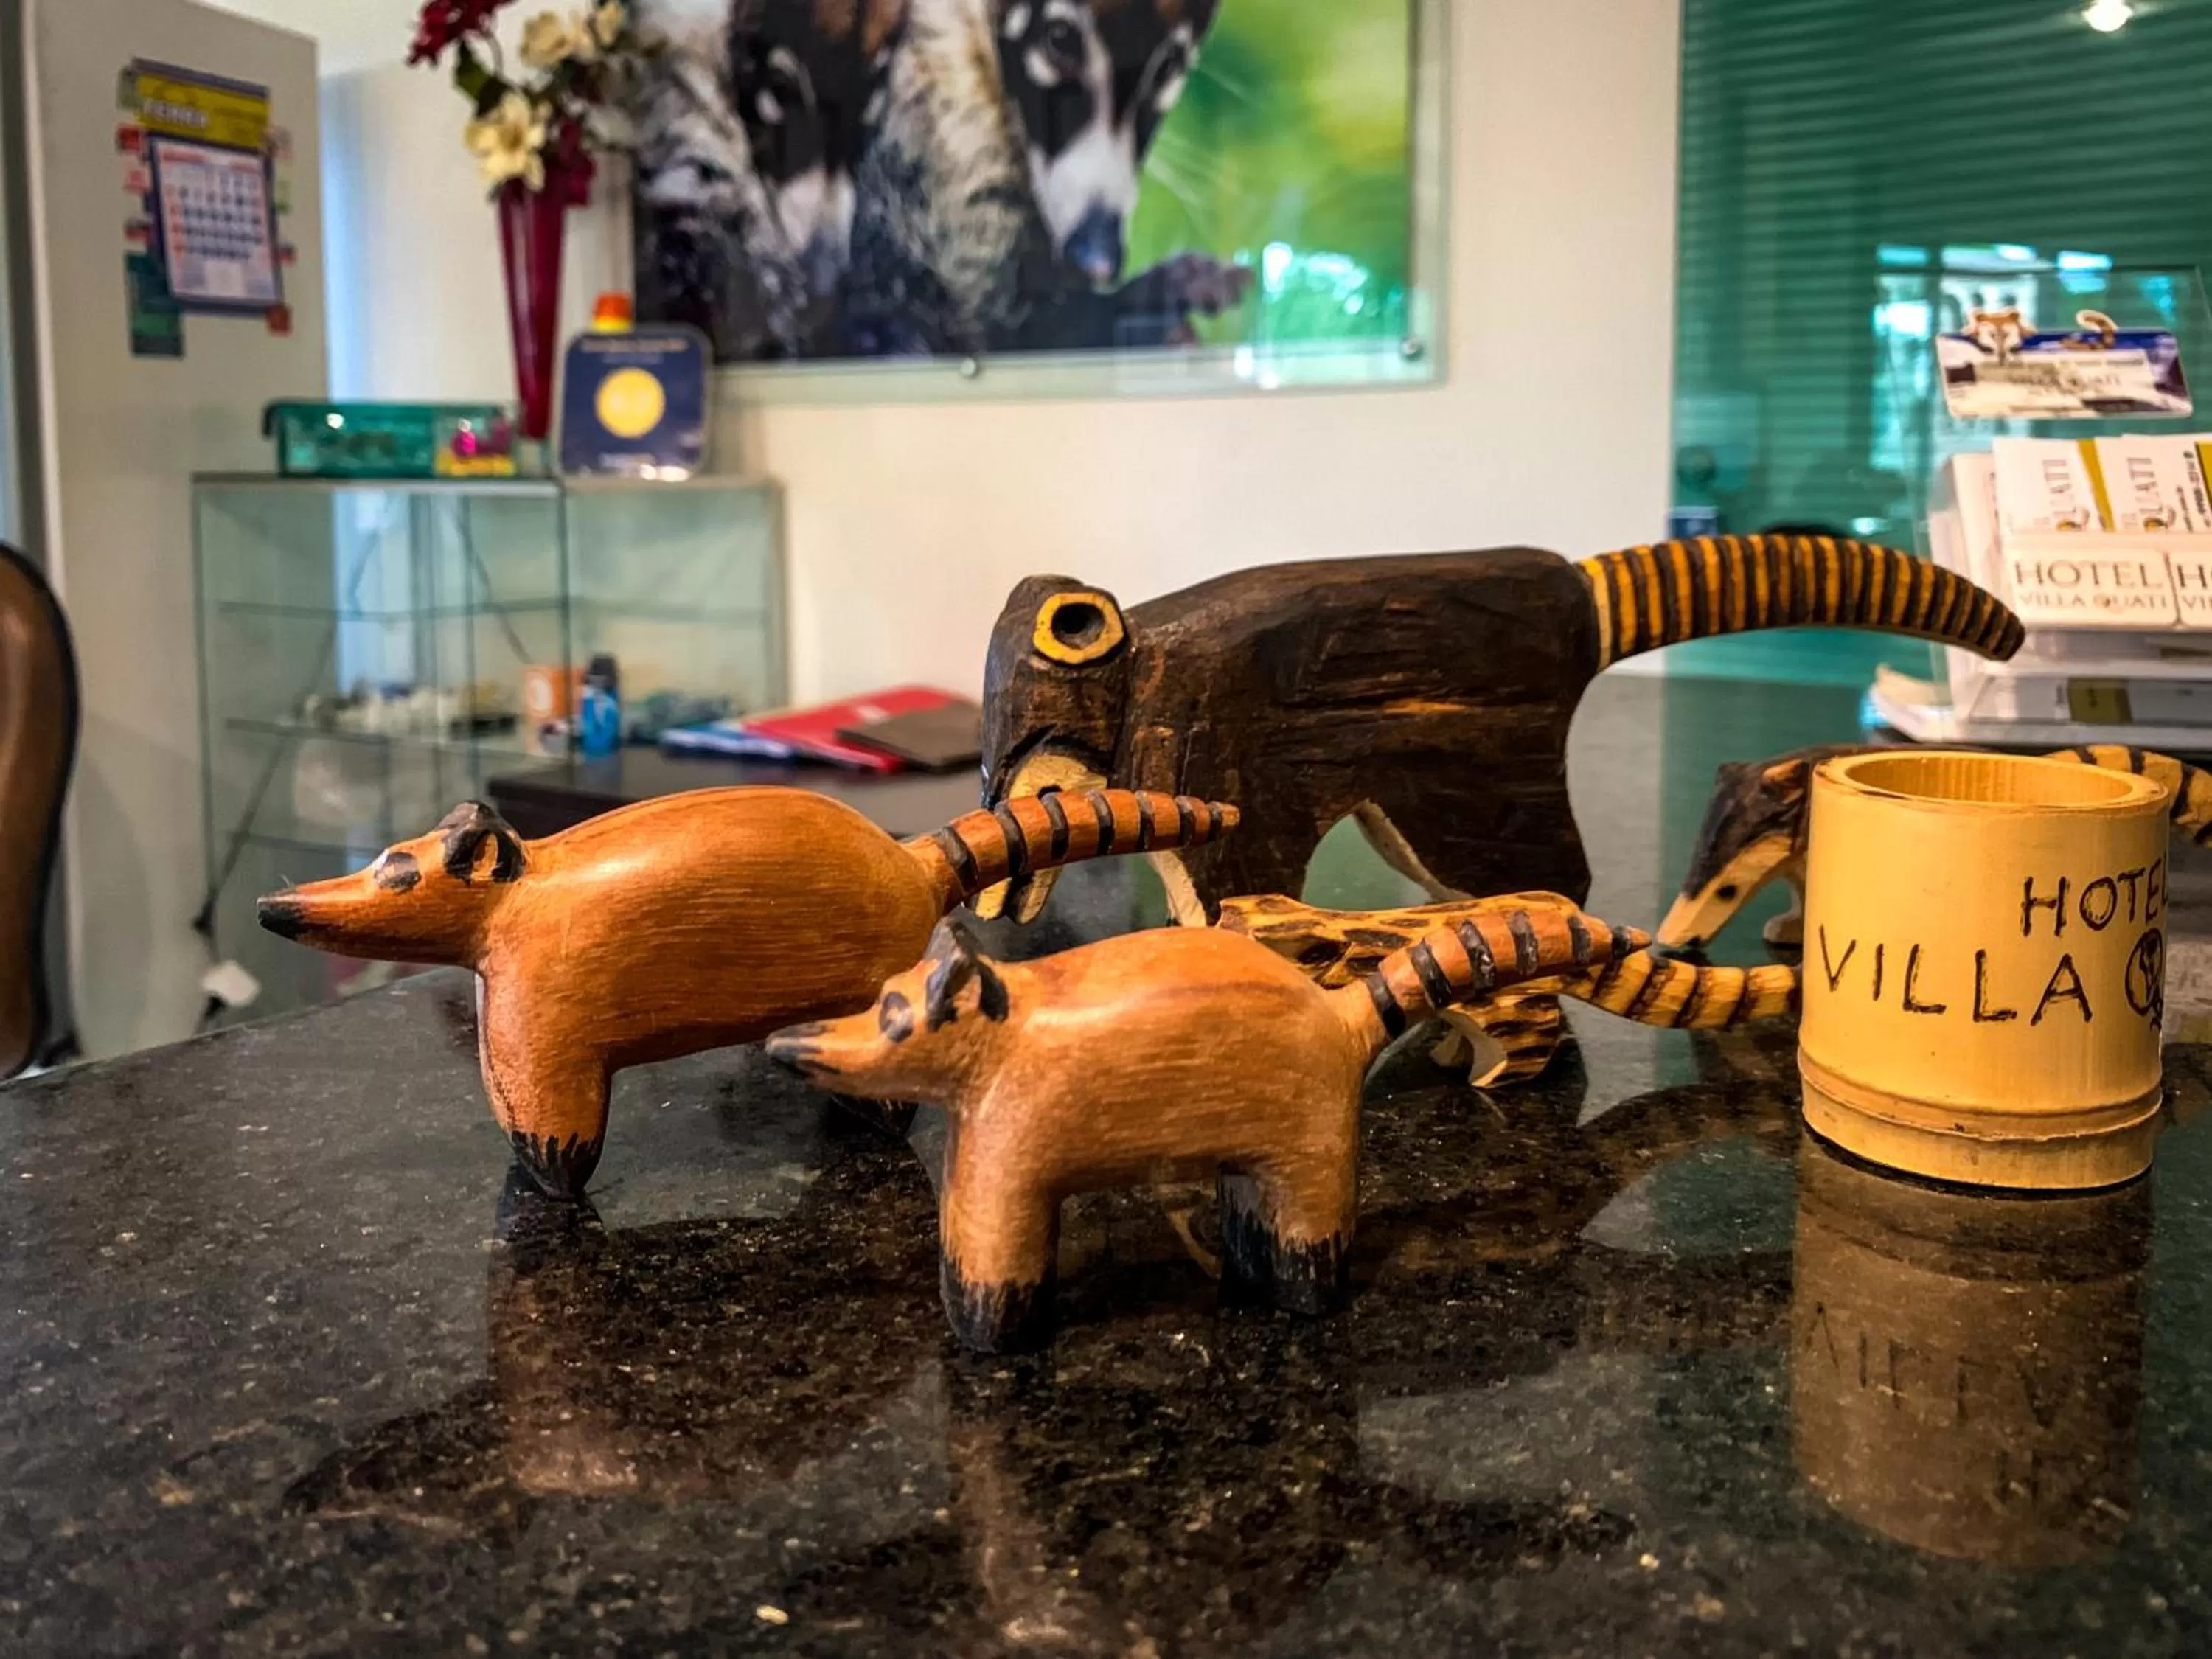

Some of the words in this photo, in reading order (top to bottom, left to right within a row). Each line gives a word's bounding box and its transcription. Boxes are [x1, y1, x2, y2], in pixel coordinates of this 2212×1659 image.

[2014, 560, 2162, 588] HOTEL
[2020, 594, 2085, 608] VILLA
[1820, 924, 2092, 1026] VILLA
